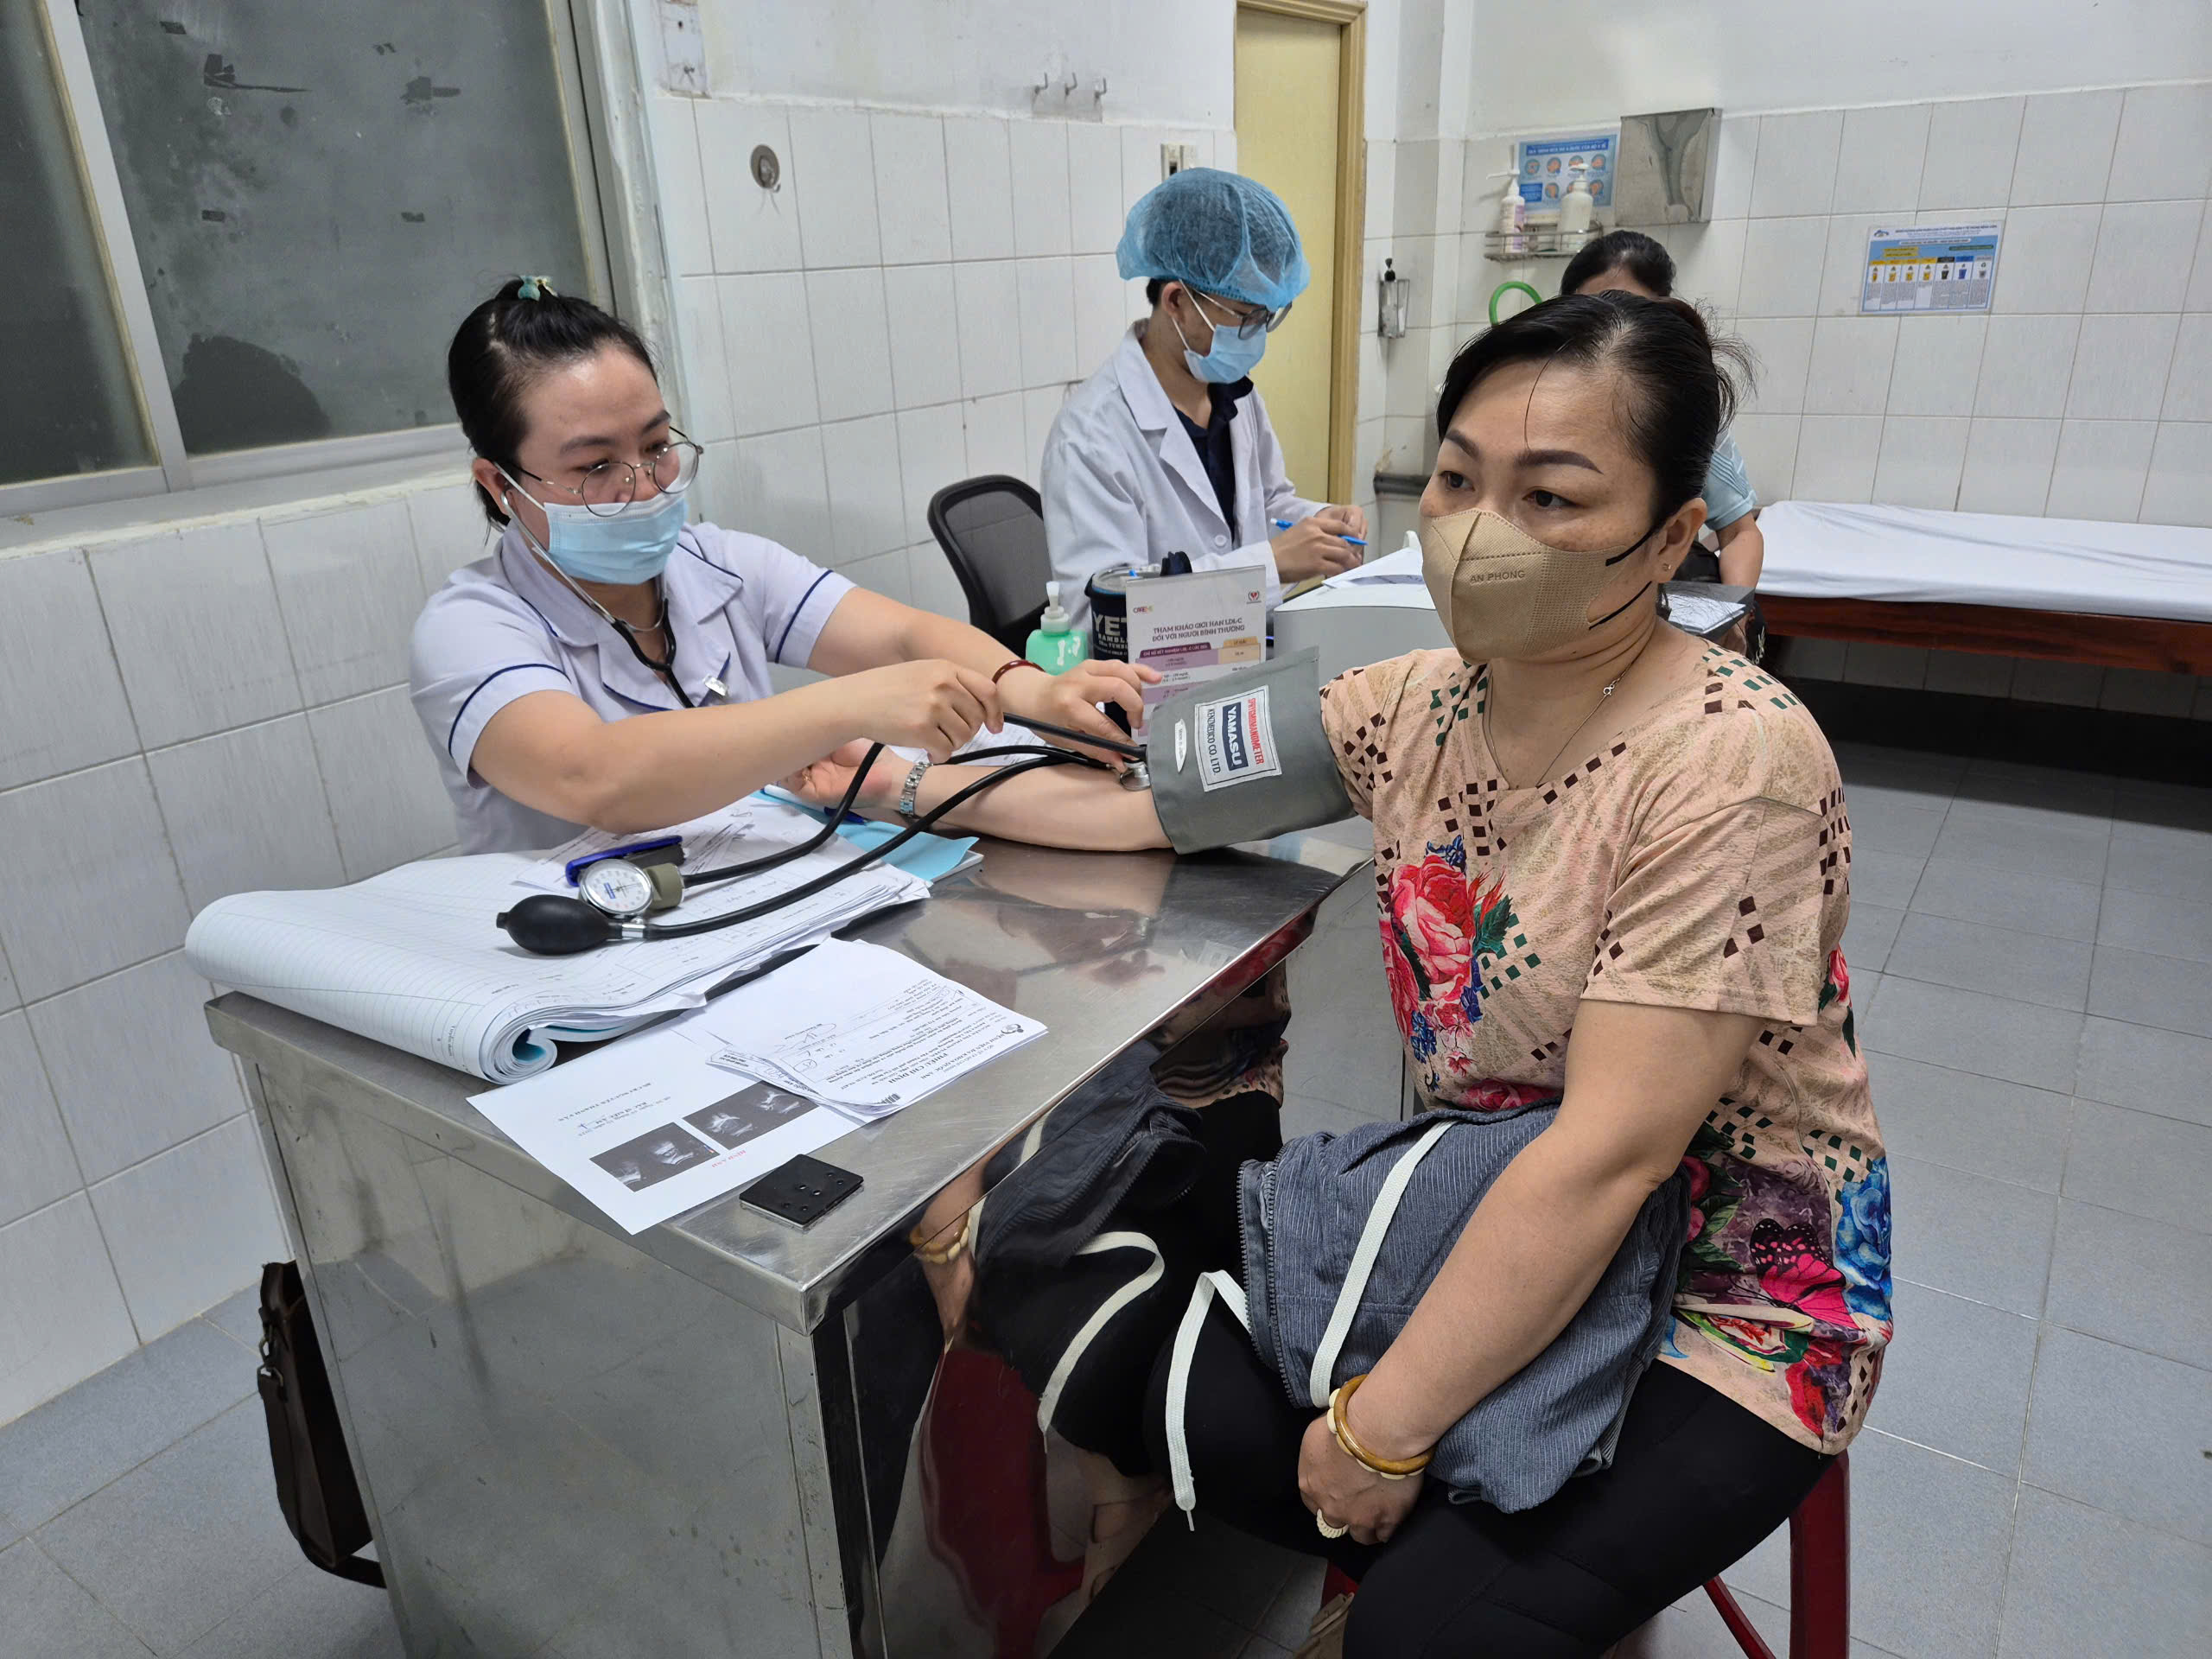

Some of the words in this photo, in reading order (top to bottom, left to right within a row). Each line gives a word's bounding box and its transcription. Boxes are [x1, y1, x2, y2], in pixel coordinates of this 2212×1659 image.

[1488, 570, 1526, 581] PHONG
[1152, 632, 1164, 642] ĐỐI
[1166, 632, 1177, 640] VỚI
[1179, 629, 1198, 639] NGƯỜI
[1200, 627, 1217, 637] BÌNH
[1217, 625, 1245, 633] THƯỜNG
[1154, 626, 1173, 634] THAM
[1175, 623, 1193, 632] KHẢO
[1228, 705, 1243, 766] YAMASU
[1211, 758, 1222, 775] LTD.
[922, 1052, 950, 1066] PHIẾU
[907, 1065, 926, 1074] CHỈ
[886, 1071, 911, 1084] ĐỊNH
